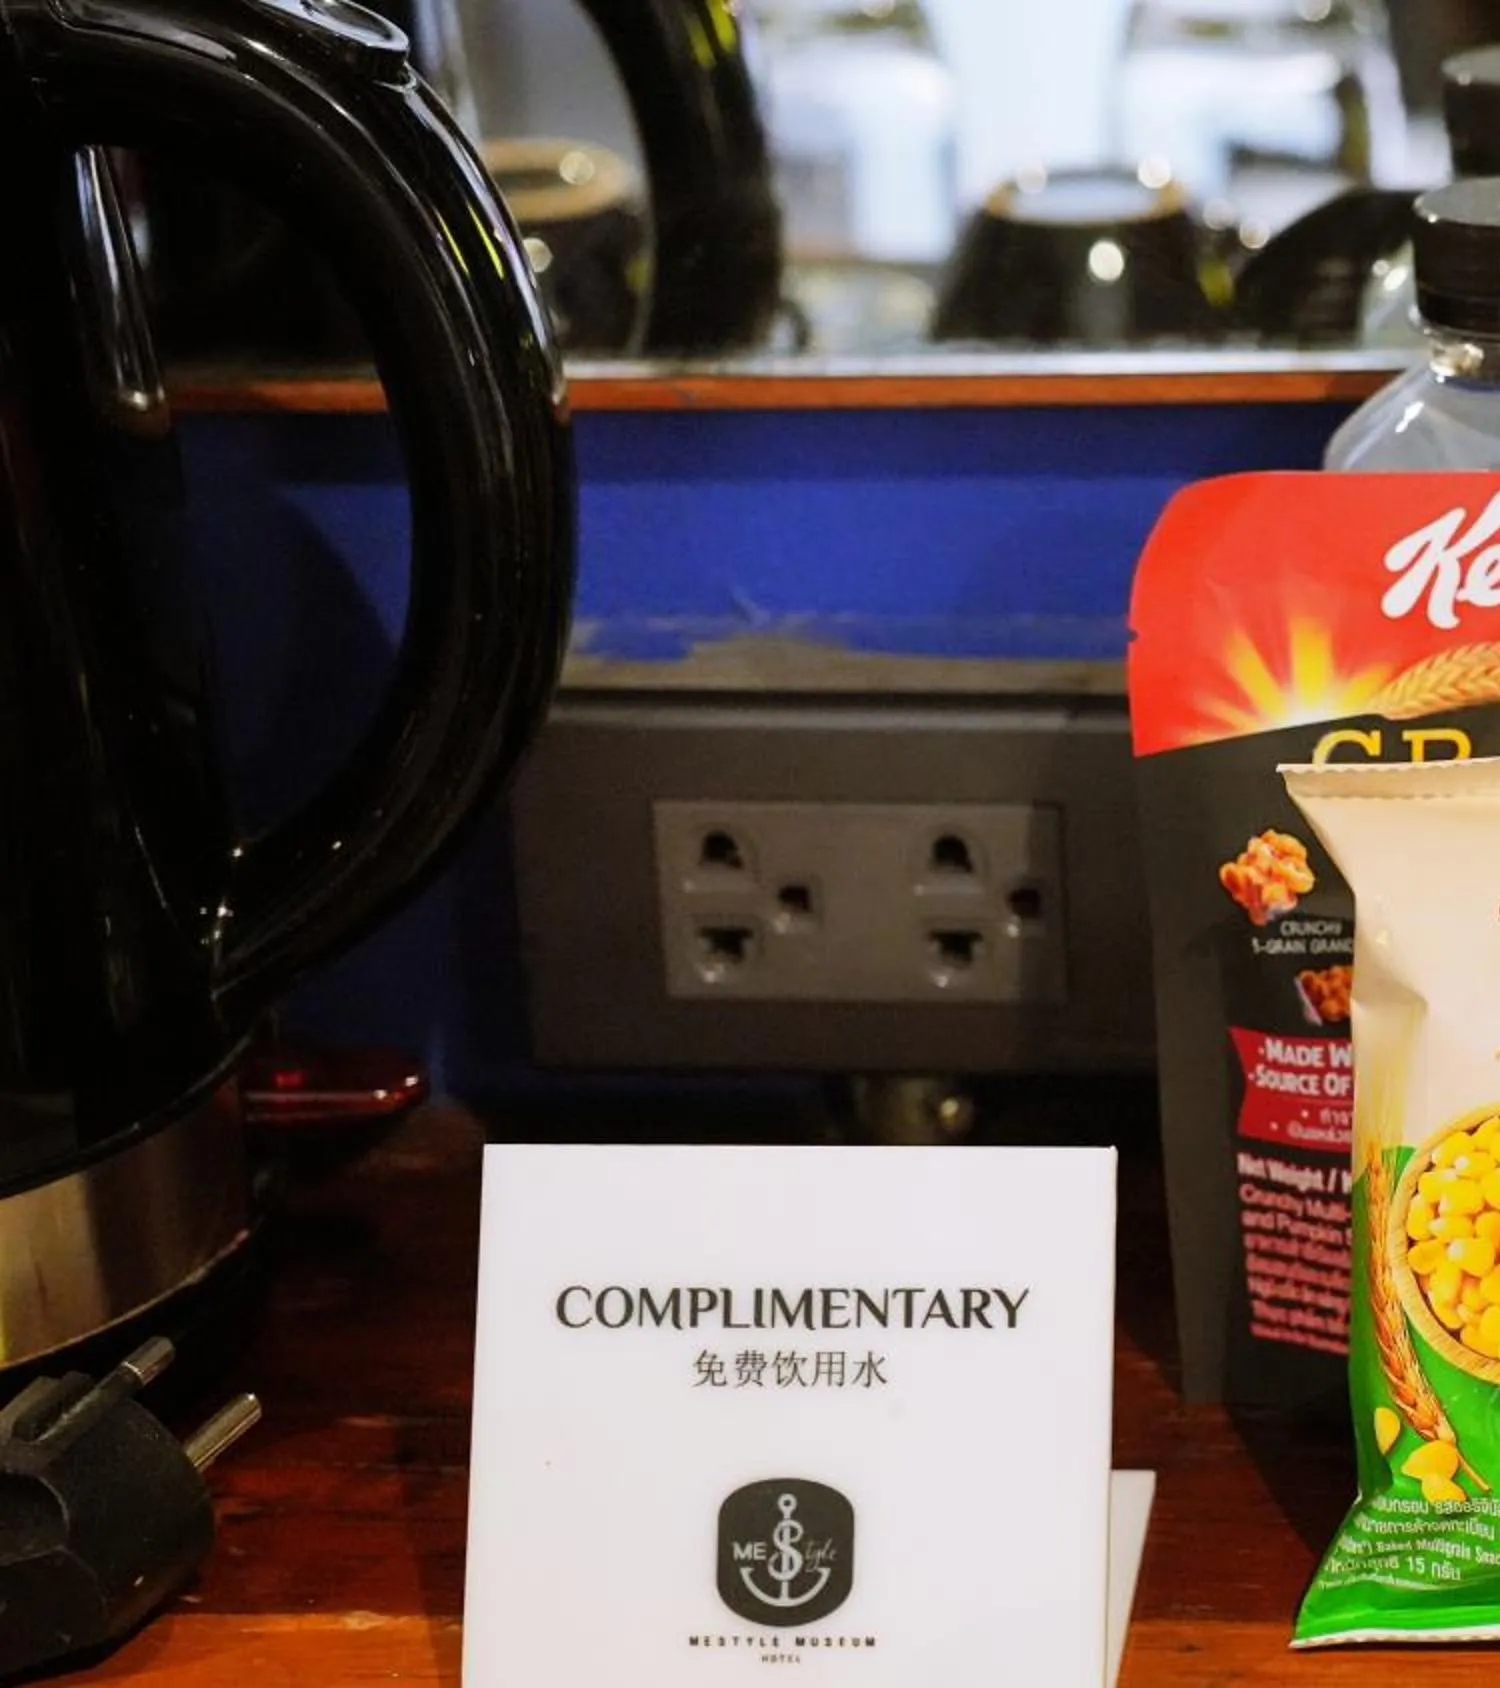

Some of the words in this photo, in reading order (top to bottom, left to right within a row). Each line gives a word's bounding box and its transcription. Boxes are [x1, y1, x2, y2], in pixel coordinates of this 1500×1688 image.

[1265, 1038, 1325, 1068] MADE
[1255, 1063, 1320, 1096] SOURCE
[556, 1285, 1030, 1331] COMPLIMENTARY
[692, 1348, 889, 1390] 免费饮用水
[1408, 1556, 1425, 1575] 15
[795, 1636, 876, 1648] MUSEUM
